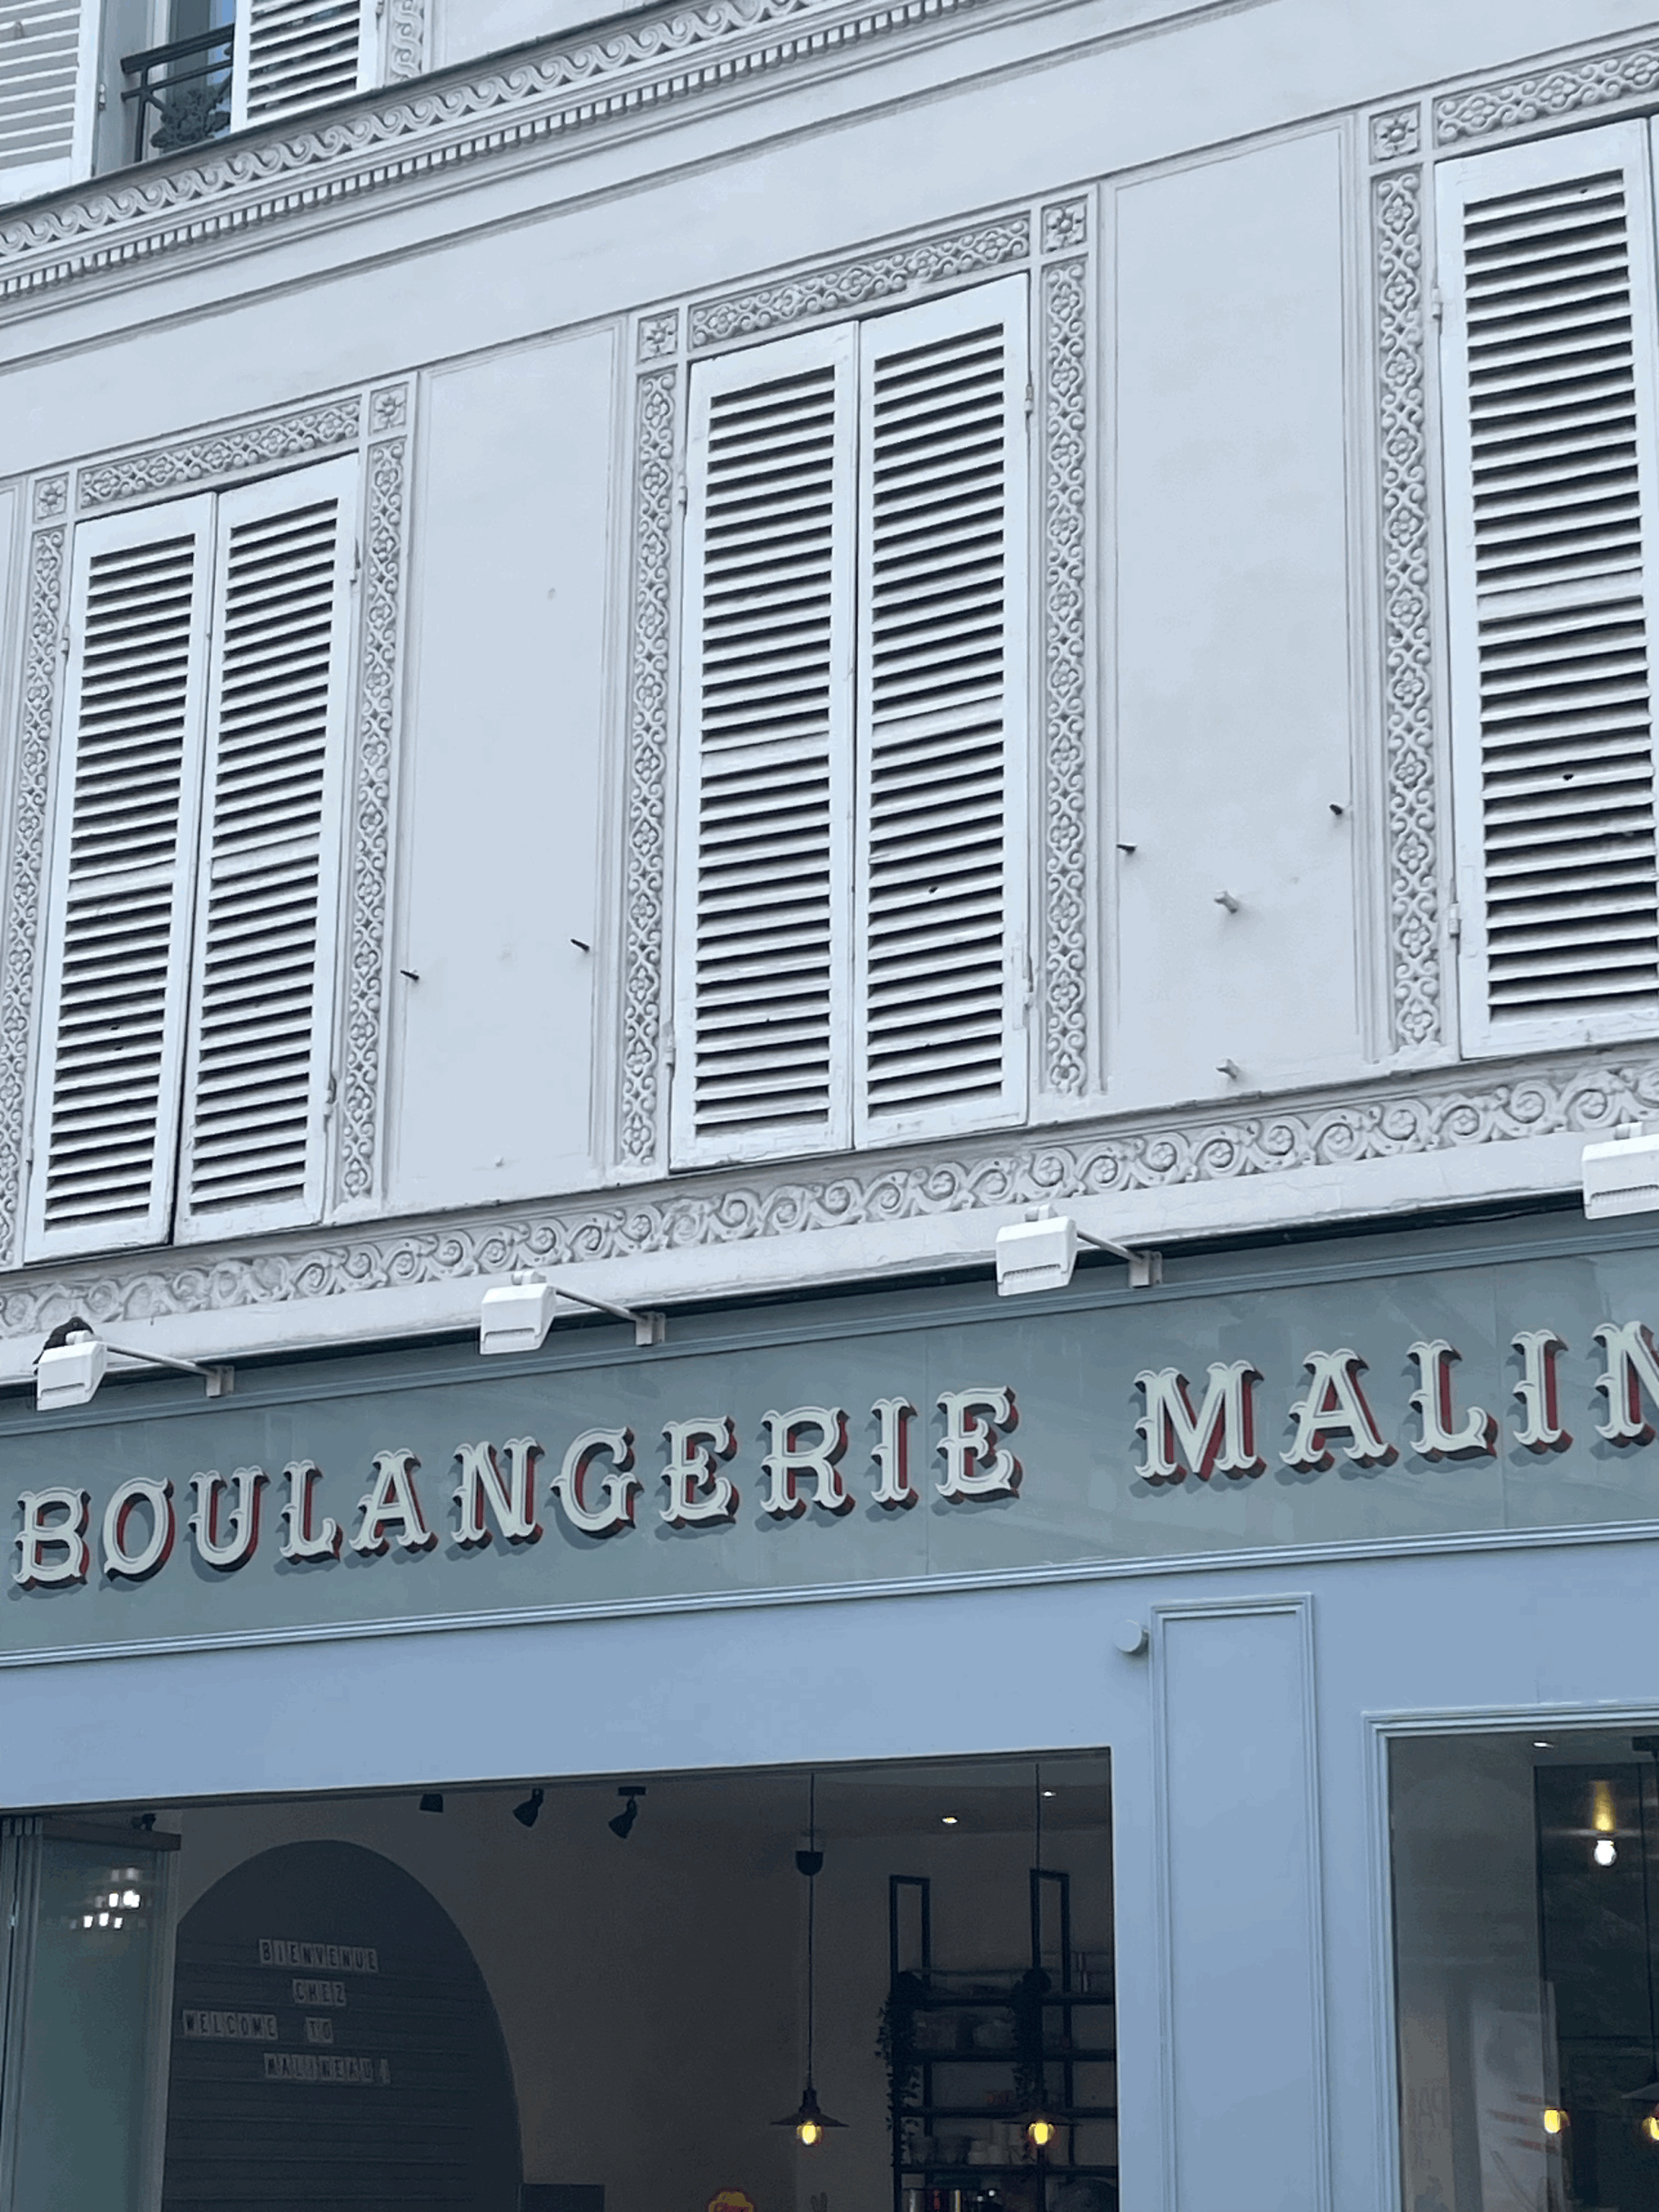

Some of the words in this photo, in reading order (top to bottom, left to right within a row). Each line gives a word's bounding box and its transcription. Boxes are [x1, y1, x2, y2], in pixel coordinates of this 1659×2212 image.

[12, 1385, 1023, 1588] BOULANGERIE
[260, 1940, 378, 1971] BIENVENUE
[294, 1980, 345, 2004] CHEZ
[184, 2011, 276, 2038] WELCOME
[307, 2019, 332, 2041] TO
